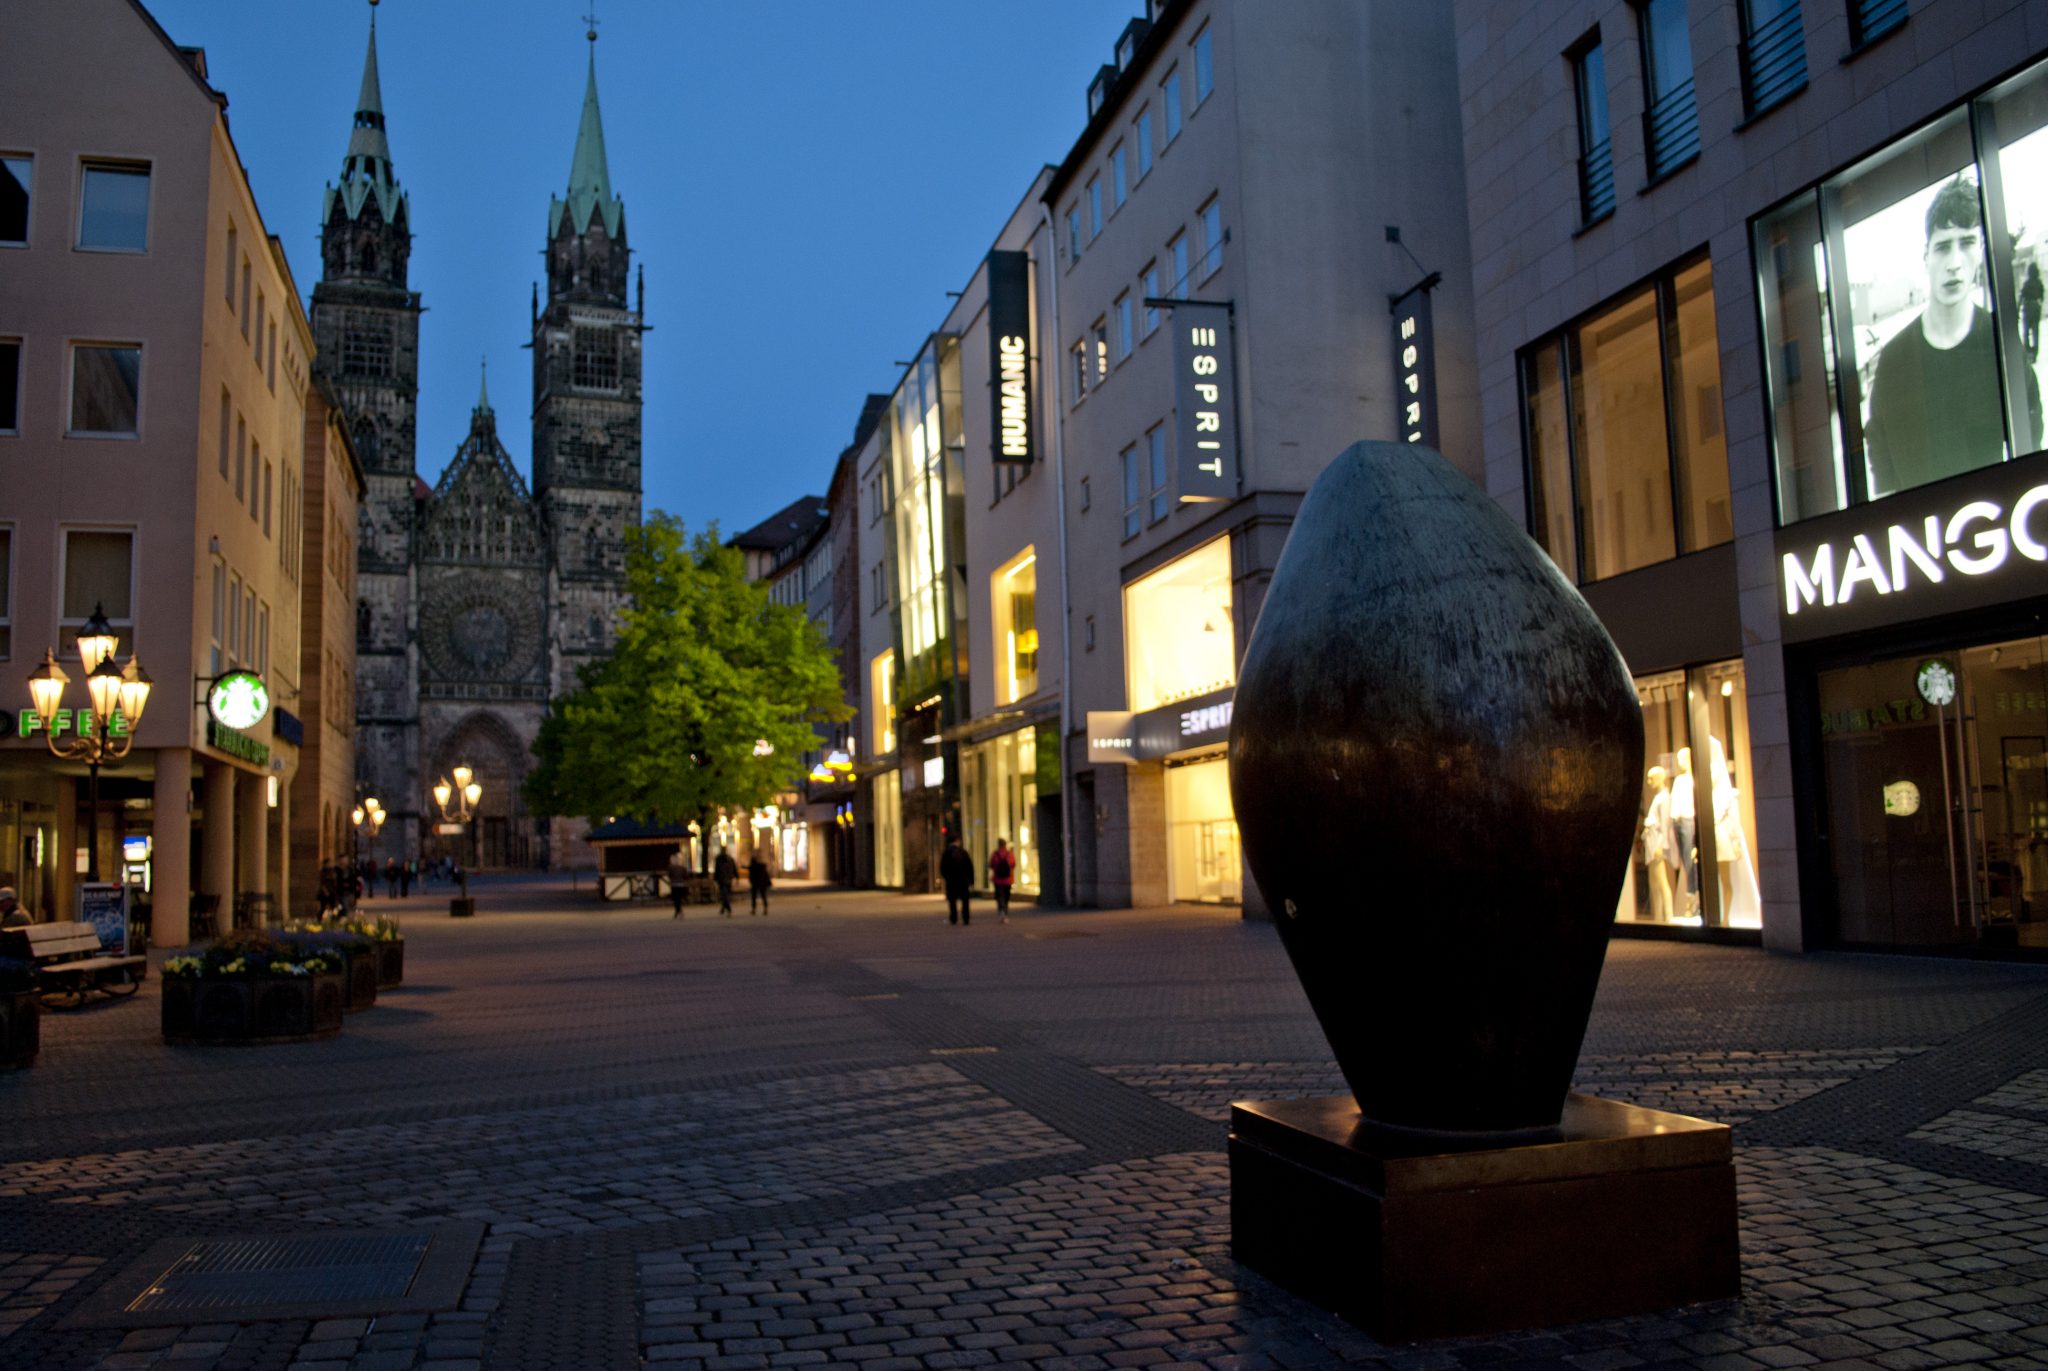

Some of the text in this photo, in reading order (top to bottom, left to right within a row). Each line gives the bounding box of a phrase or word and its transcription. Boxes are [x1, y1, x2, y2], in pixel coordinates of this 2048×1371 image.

[1000, 335, 1028, 457] HUMANIC
[1191, 327, 1222, 478] ESPRIT
[1092, 737, 1132, 749] ESPRIT
